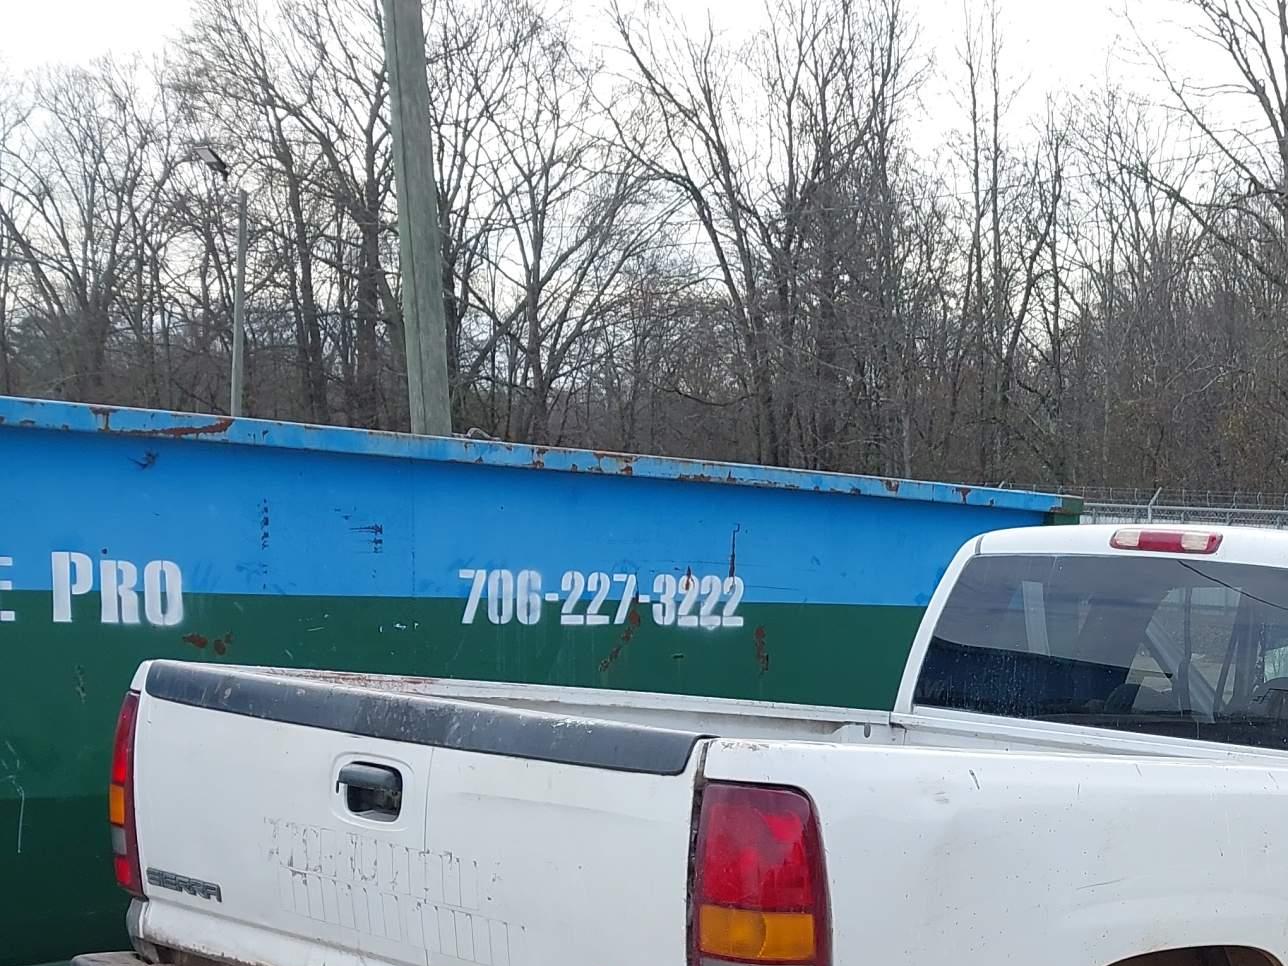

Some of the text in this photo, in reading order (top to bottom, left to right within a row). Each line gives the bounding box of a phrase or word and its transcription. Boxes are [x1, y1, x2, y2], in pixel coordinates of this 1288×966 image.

[51, 551, 184, 626] PRO
[459, 569, 745, 628] 706-227-3222
[146, 867, 222, 903] SIERRA
